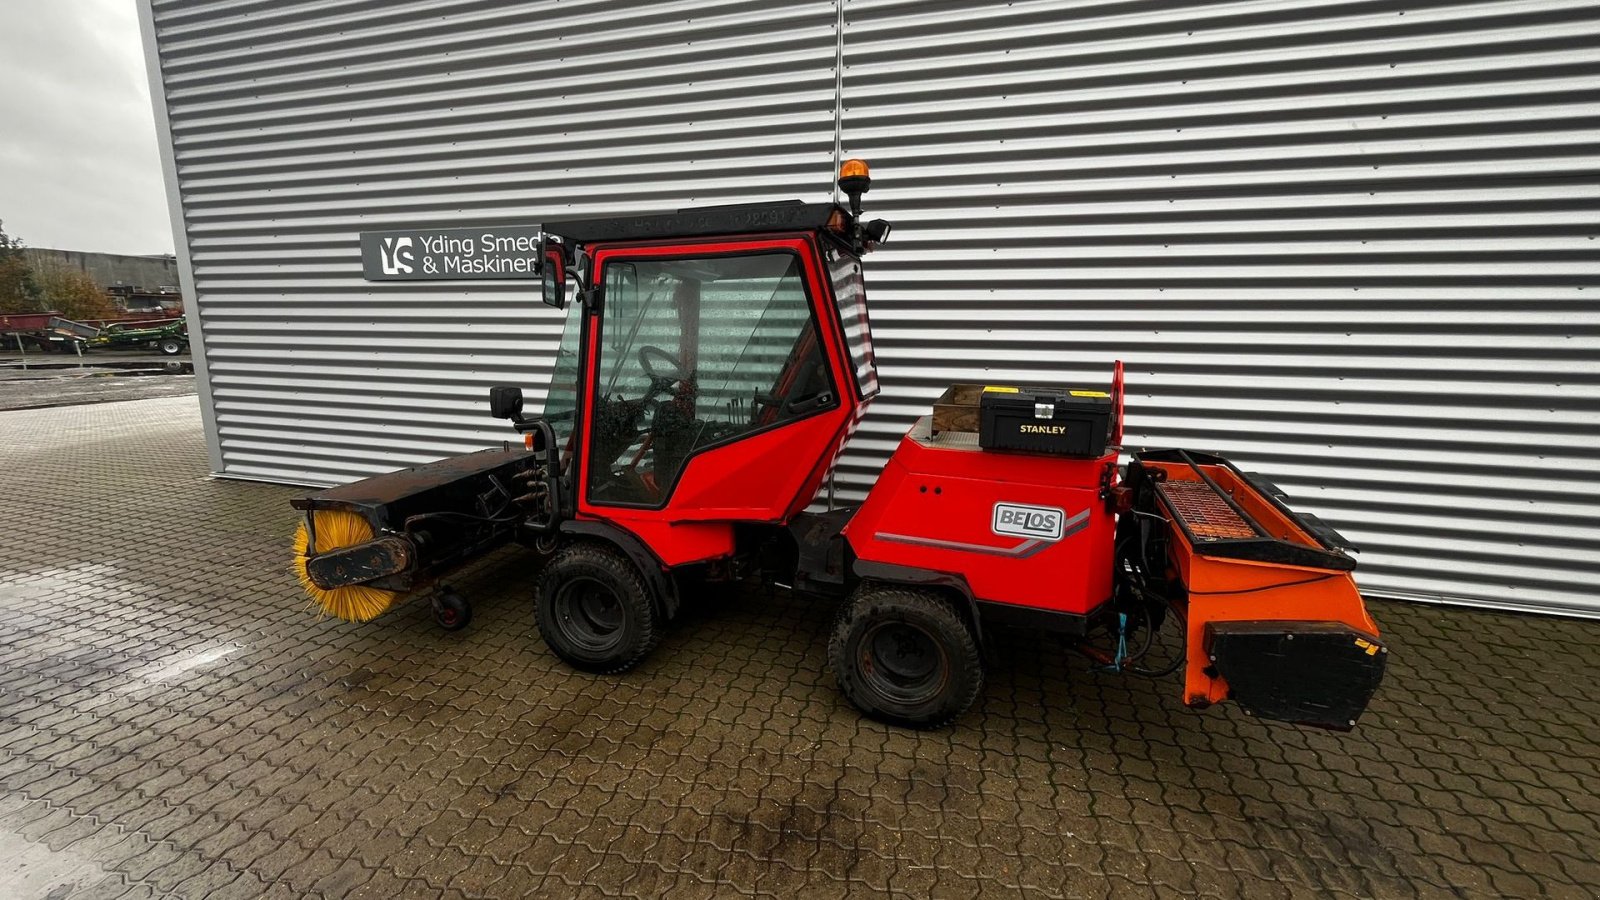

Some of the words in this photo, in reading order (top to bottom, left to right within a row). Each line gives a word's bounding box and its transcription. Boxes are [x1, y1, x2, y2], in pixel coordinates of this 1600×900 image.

[419, 234, 474, 257] Yding
[481, 231, 561, 252] Smed
[423, 255, 440, 274] &
[1020, 424, 1066, 435] STANLEY
[1000, 509, 1057, 533] BELOS
